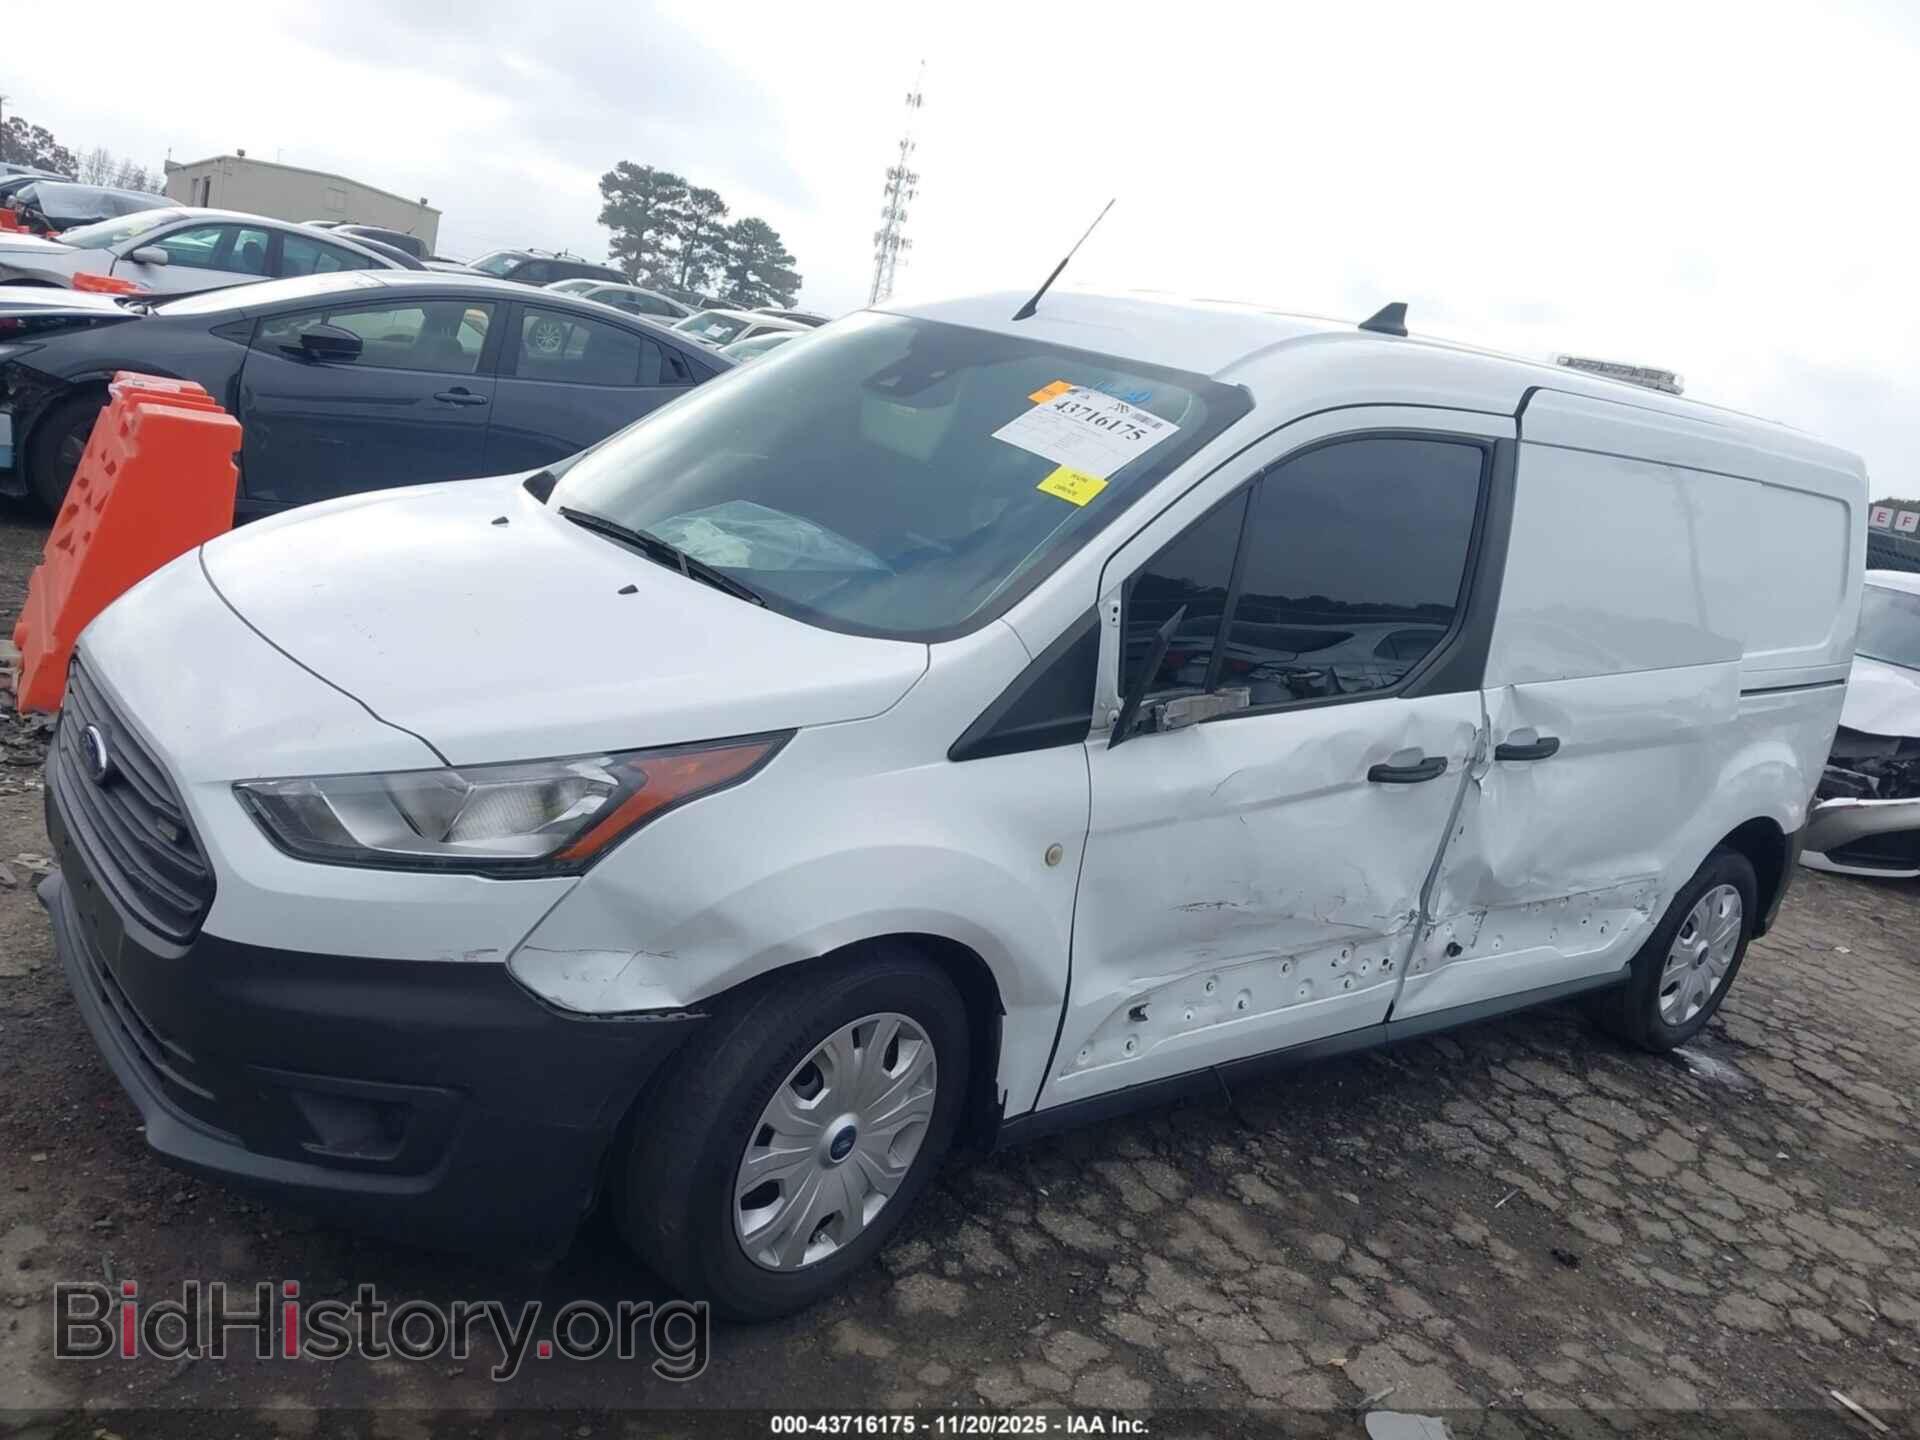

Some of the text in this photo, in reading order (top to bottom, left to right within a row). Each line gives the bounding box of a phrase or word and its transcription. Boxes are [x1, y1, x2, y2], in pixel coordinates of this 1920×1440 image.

[1054, 400, 1148, 440] 43716175
[1876, 511, 1888, 523] E
[1902, 516, 1915, 527] F
